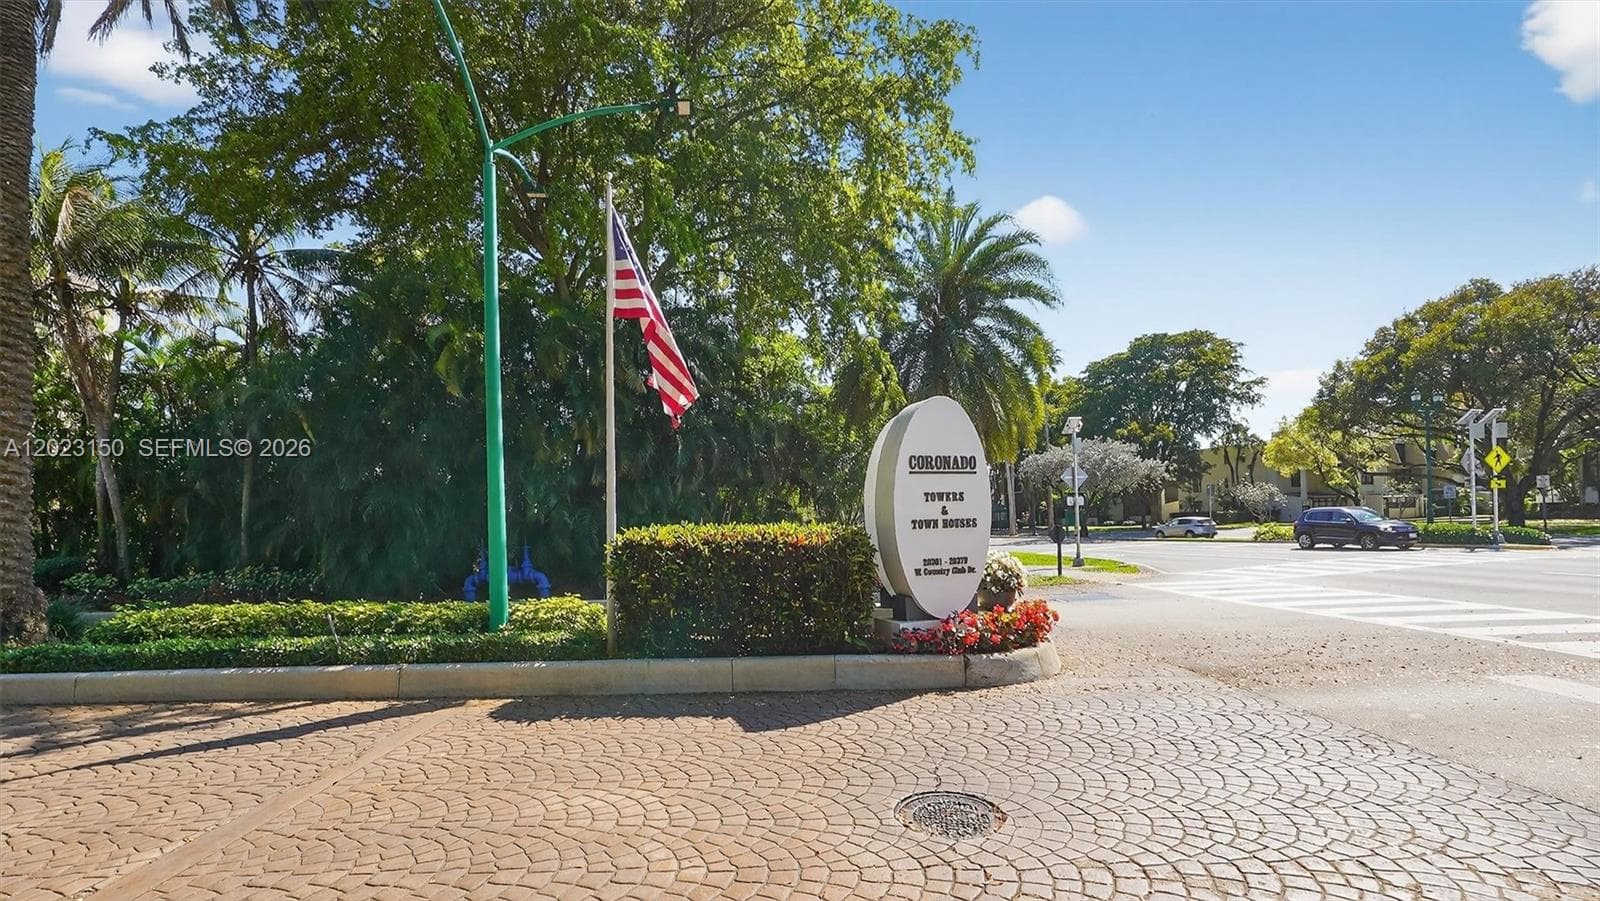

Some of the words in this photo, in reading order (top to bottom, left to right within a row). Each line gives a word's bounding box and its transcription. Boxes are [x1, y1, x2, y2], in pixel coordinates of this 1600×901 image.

[909, 455, 976, 470] CORONADO
[924, 492, 964, 502] TOWERS
[941, 505, 948, 515] &
[911, 519, 939, 529] TOWN
[942, 518, 977, 528] HOUSES
[923, 568, 950, 576] Country
